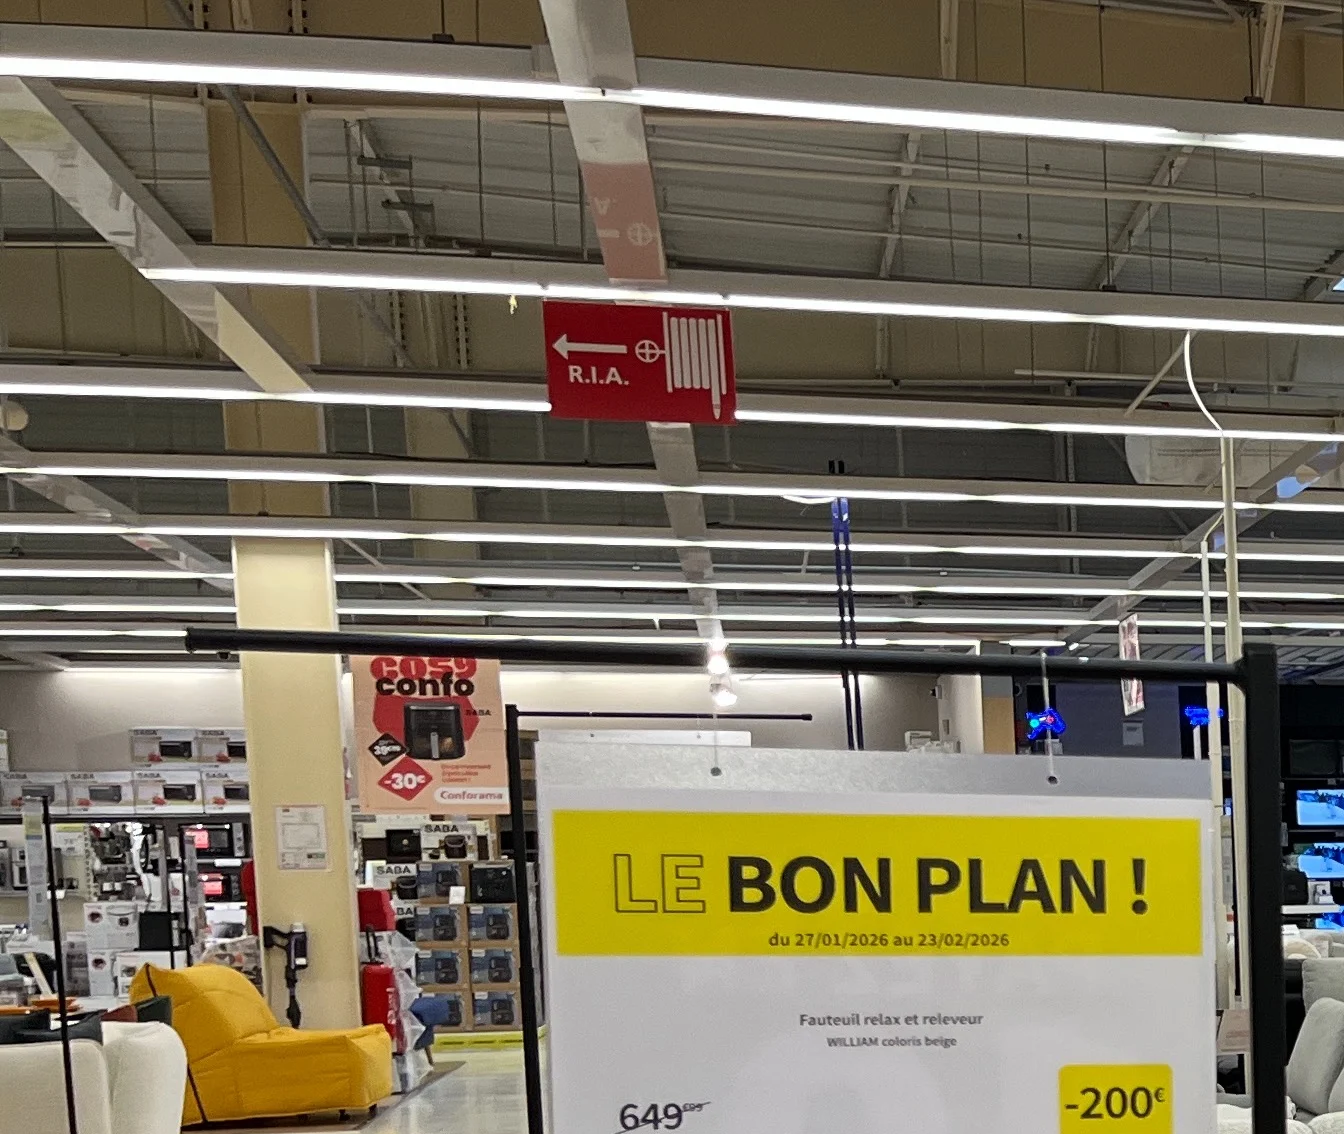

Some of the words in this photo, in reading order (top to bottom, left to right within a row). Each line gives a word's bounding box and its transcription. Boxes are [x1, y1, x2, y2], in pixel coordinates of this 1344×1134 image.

[568, 364, 630, 386] R.I.A.
[375, 671, 475, 697] confo
[440, 789, 503, 801] Conforama
[424, 824, 459, 834] SABA
[376, 865, 411, 875] SABA
[612, 853, 707, 915] LE
[727, 854, 892, 915] BON
[916, 857, 1107, 916] PLAN
[1130, 858, 1149, 916] !
[768, 931, 791, 949] du
[795, 932, 889, 950] 27/01/2026
[893, 935, 915, 949] au
[918, 931, 1010, 949] 23/02/2026
[799, 1011, 861, 1027] Fauteuil
[865, 1012, 900, 1027] relax
[903, 1014, 920, 1027] et
[923, 1012, 984, 1027] releveur
[826, 1035, 879, 1049] WILLIAM
[881, 1034, 922, 1049] coloris
[925, 1034, 958, 1051] beige
[1064, 1086, 1165, 1121] -200€
